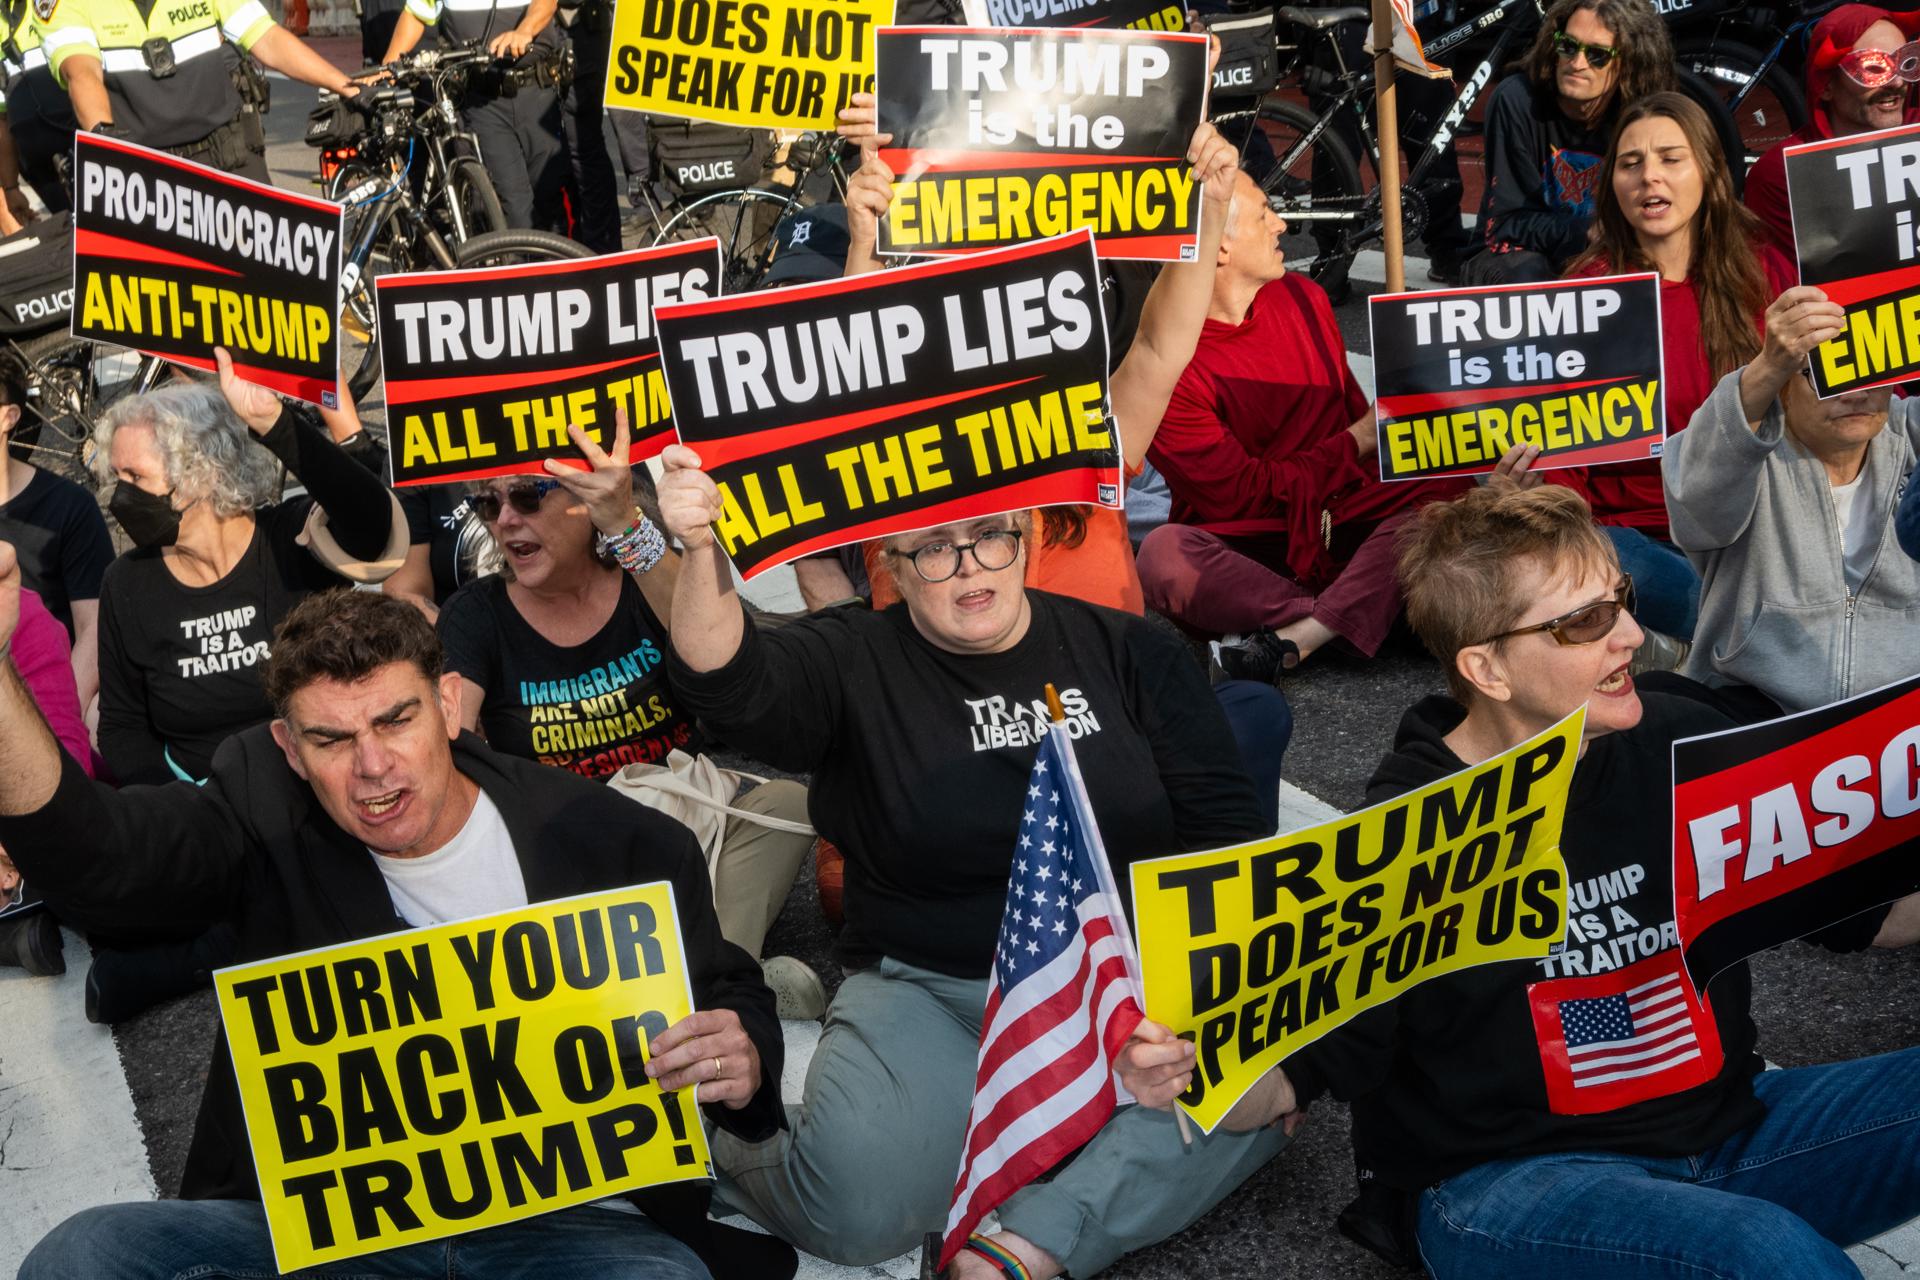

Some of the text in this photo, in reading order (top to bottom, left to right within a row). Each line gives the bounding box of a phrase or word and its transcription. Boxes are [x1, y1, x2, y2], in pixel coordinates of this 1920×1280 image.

[168, 2, 211, 25] POLICE
[640, 0, 872, 63] DOES NOT
[614, 45, 746, 112] SPEAK
[750, 64, 827, 118] FOR
[920, 37, 1170, 98] TRUMP
[968, 100, 1125, 150] is the
[1431, 60, 1492, 154] NYPD
[678, 160, 736, 186] POLICE
[889, 167, 1197, 246] EMERGENCY
[1836, 141, 1920, 210] TR
[83, 161, 335, 280] PRO-DEMOCRACY
[1896, 210, 1920, 261] i
[81, 271, 330, 364] ANTI-TRUMP
[394, 288, 591, 364] TRUMP
[681, 270, 1092, 419] TRUMP LIES
[1406, 288, 1621, 346] TRUMP
[1449, 345, 1586, 386] is the
[402, 408, 496, 469] ALL
[502, 388, 602, 452] THE
[1386, 380, 1658, 474] EMERGENCY
[715, 464, 825, 558] ALL
[825, 424, 952, 511] THE
[955, 381, 1111, 477] TIME
[180, 605, 256, 639] TRUMP
[201, 630, 245, 655] IS A
[178, 641, 272, 678] TRAITOR
[520, 638, 662, 706] IMMIGRANTS
[530, 688, 629, 723] ARE NOT
[532, 695, 672, 754] CRIMINALS,
[970, 710, 1101, 752] LIBERAON
[1158, 735, 1566, 938] TRUMP
[1688, 724, 1920, 902] FASC
[1188, 806, 1546, 1017] DOES NOT
[1568, 864, 1645, 913] RUMP
[1355, 903, 1464, 1000] FOR
[1476, 868, 1561, 946] US
[1535, 920, 1679, 978] TRAITOR
[1569, 905, 1639, 944] IS A
[232, 901, 666, 1056] TURN YOUR
[263, 1017, 542, 1164] BACK
[282, 1091, 696, 1250] TRUMP!
